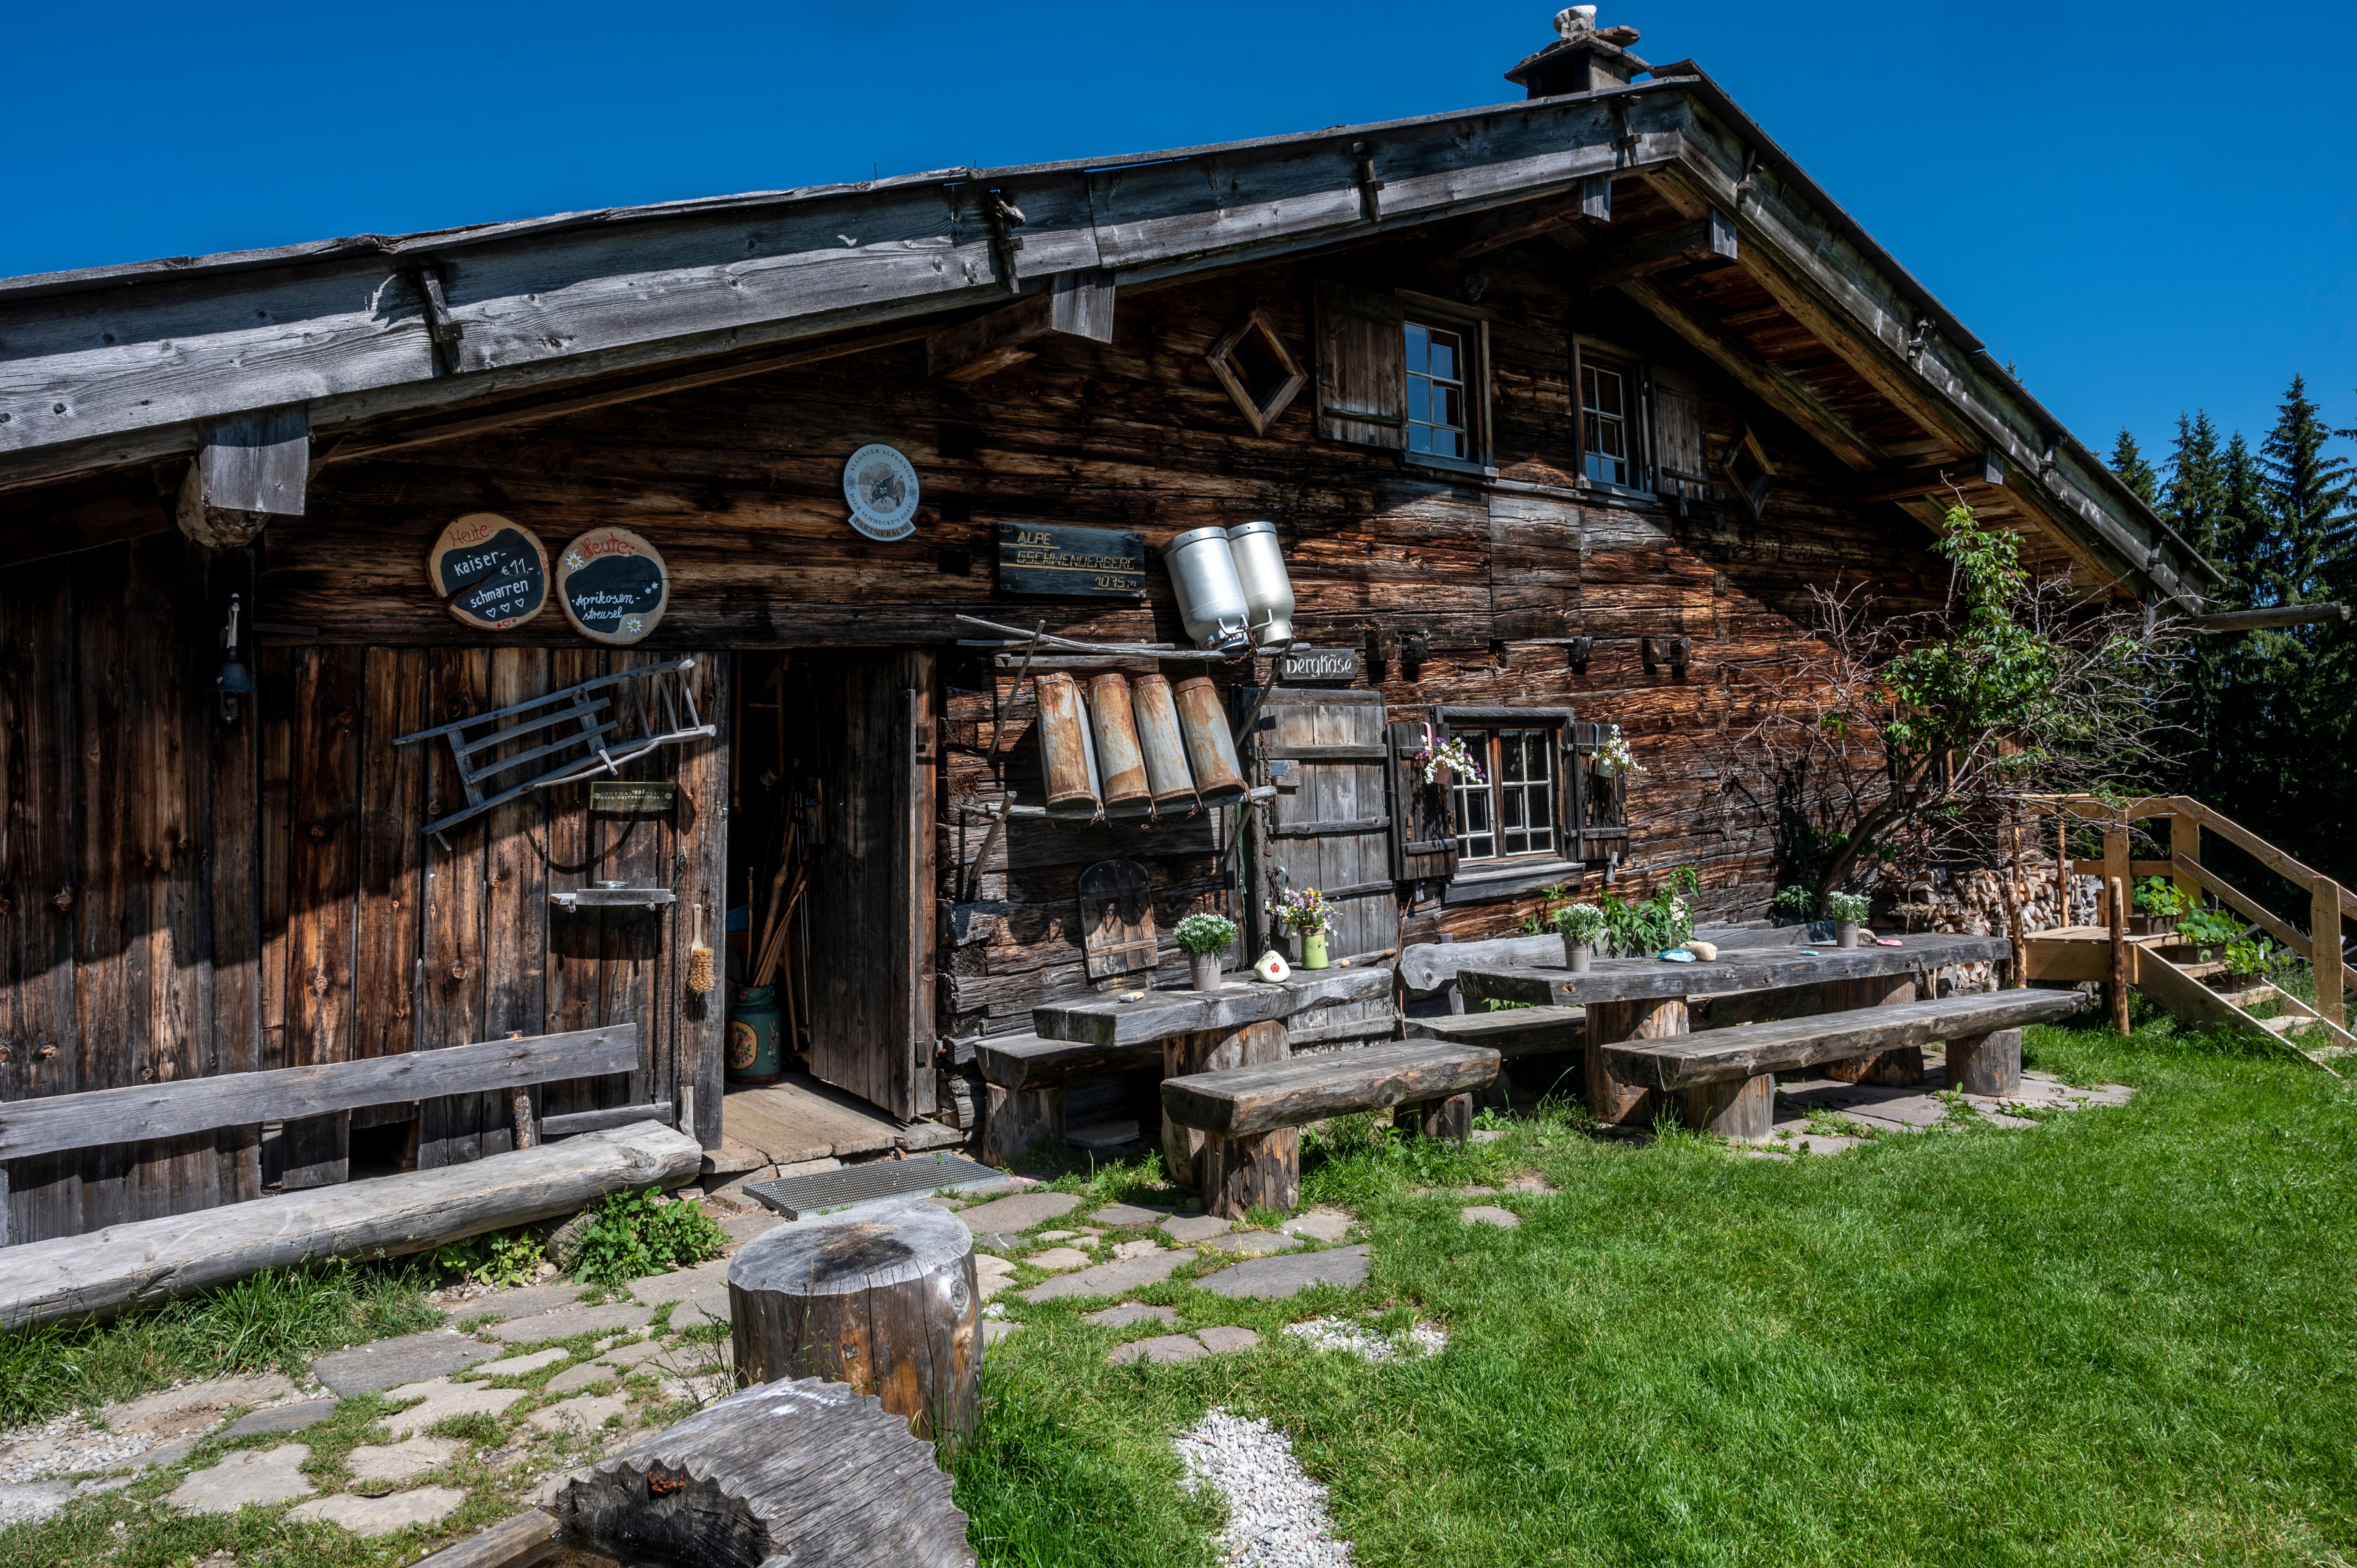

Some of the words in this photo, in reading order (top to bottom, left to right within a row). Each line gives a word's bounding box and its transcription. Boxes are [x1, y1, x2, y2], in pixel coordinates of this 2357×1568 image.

[850, 449, 880, 472] ALLGÄUER
[882, 450, 913, 482] ALPGENUSS
[850, 493, 861, 511] HIER
[901, 502, 913, 519] GUAT!
[449, 523, 493, 547] Heute:
[854, 518, 911, 537] PARTNERALPE
[1017, 531, 1051, 545] ALPE
[580, 532, 635, 559] Heute:
[1016, 550, 1135, 570] GSCHWENDERBERG
[1094, 576, 1125, 588] 1075
[470, 580, 529, 608] schmarren
[582, 606, 622, 621] streusel
